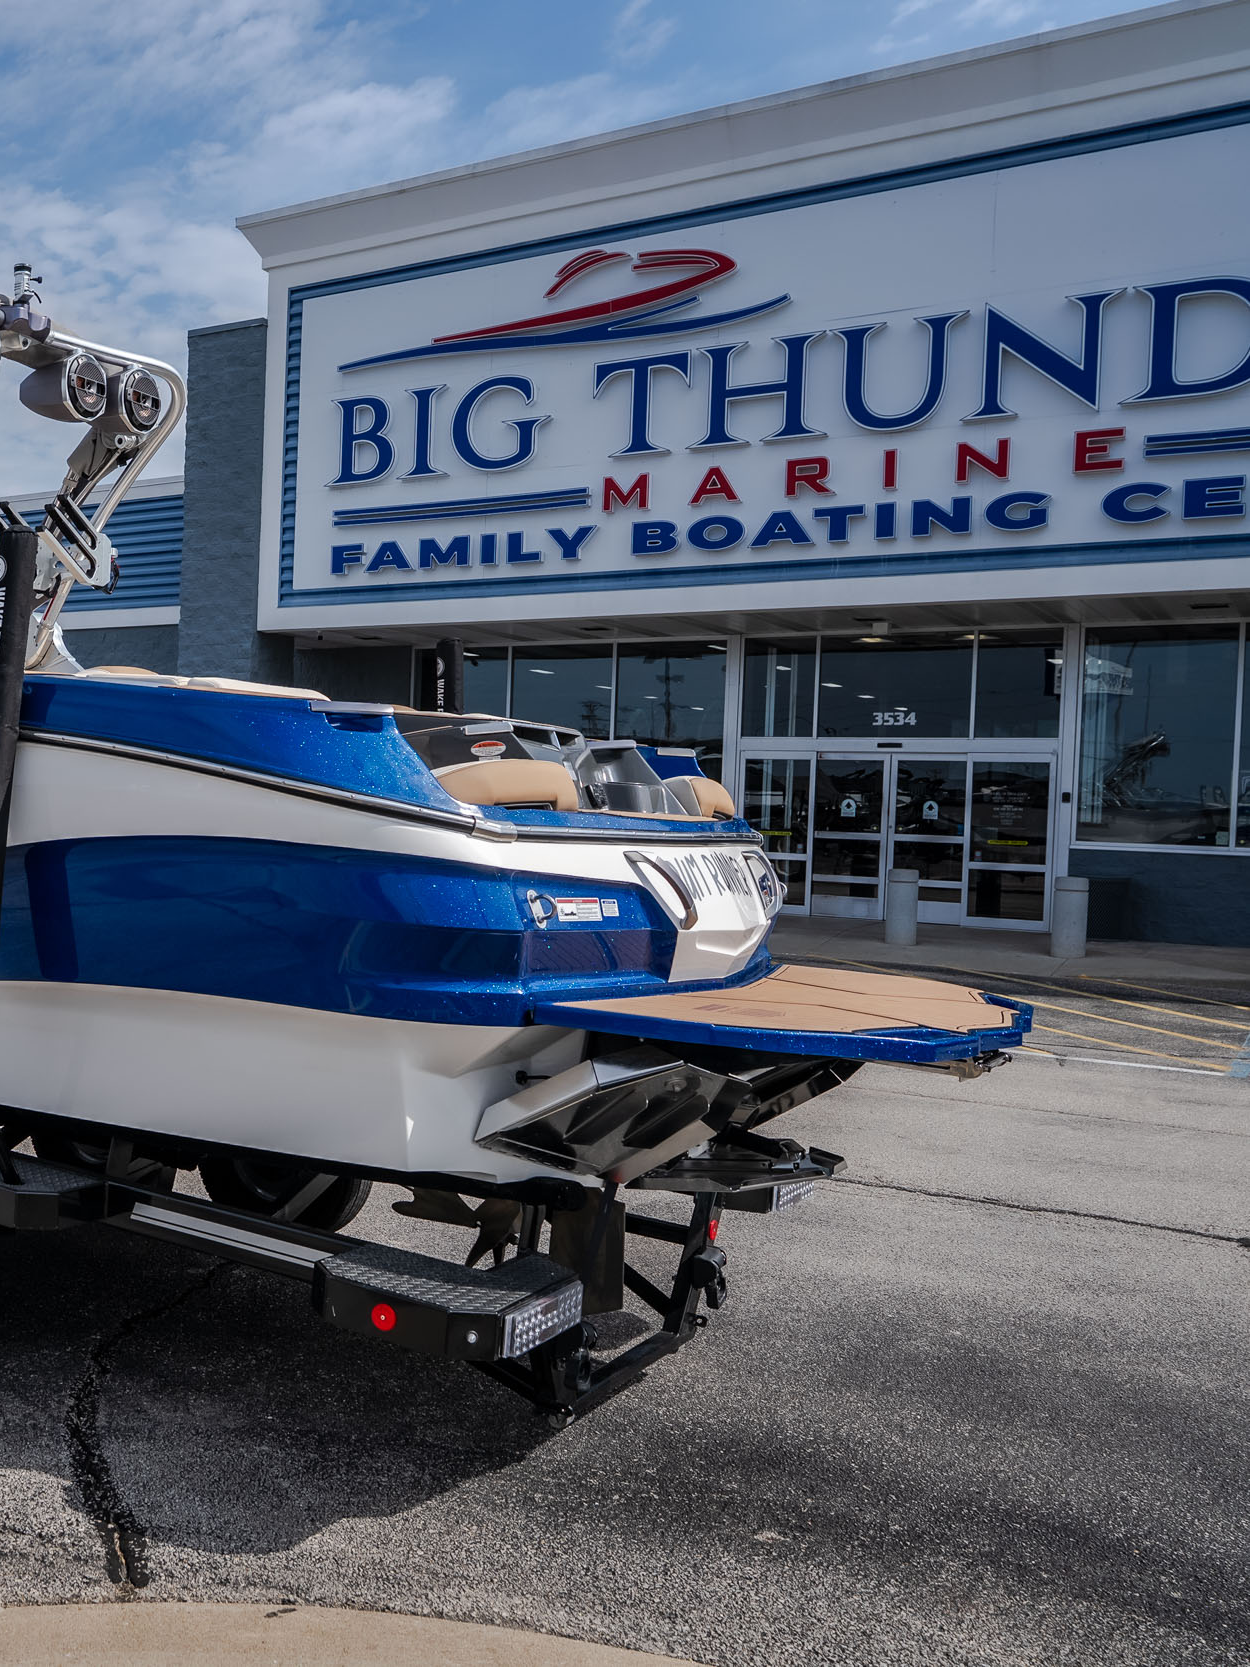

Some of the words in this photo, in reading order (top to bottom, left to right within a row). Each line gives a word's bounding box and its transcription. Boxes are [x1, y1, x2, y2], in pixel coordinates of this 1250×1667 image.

[325, 374, 553, 488] BIG
[593, 274, 1250, 458] THUND
[601, 426, 1127, 513] MARINE
[330, 523, 598, 575] FAMILY
[630, 490, 1052, 556] BOATING
[1099, 473, 1247, 524] CE
[437, 678, 445, 706] WAKE
[872, 712, 917, 726] 3534
